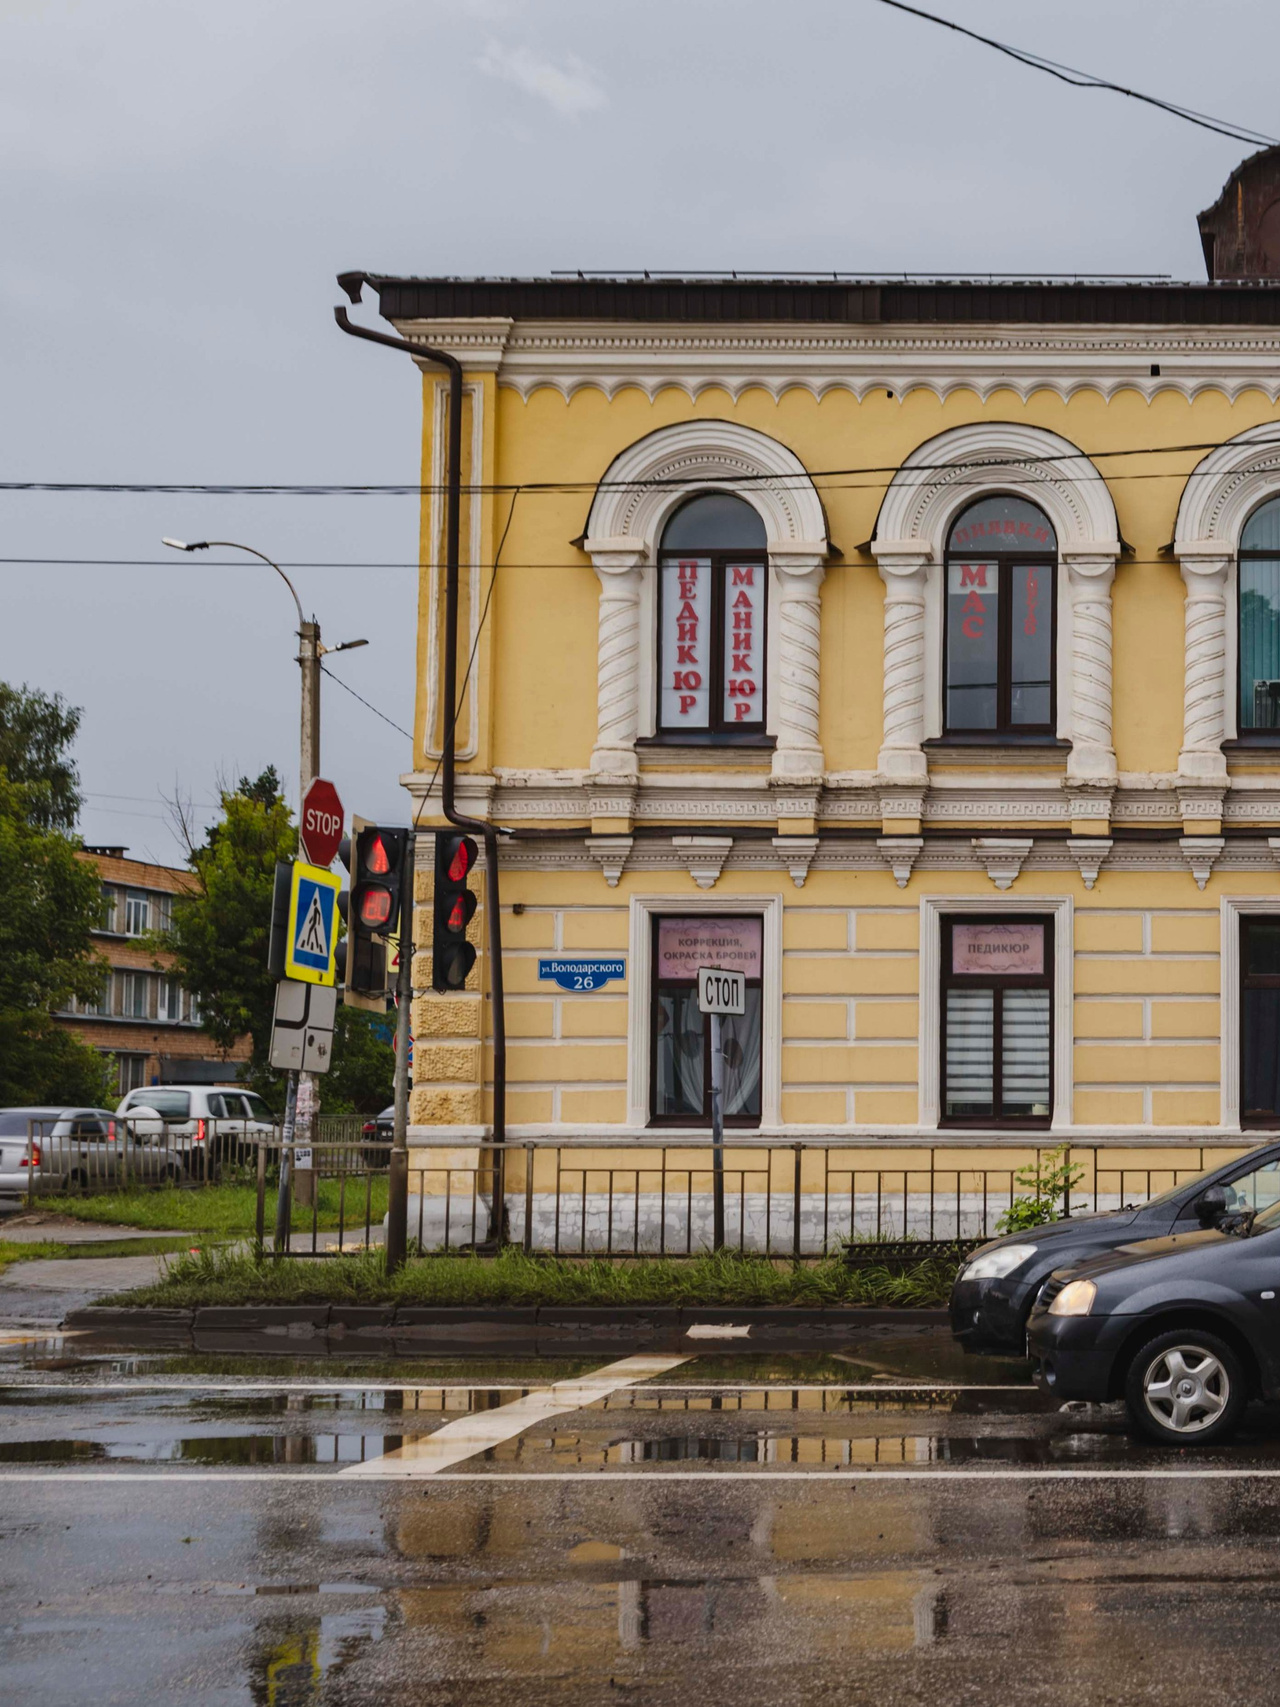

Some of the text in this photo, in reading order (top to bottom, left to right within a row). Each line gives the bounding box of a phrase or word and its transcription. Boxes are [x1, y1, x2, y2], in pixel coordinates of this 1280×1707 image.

[954, 519, 1050, 545] ПИЯВКИ
[673, 561, 702, 714] ПЕДИКЮР
[728, 567, 756, 721] МАНИКЮР
[305, 808, 341, 837] STOP
[664, 950, 757, 961] ОКРАСКА БРОВЕЙ
[678, 938, 743, 948] КОРРЕКЦИЯ,
[968, 943, 1030, 954] ПЕДИКЮР
[573, 976, 594, 989] 26
[705, 976, 739, 1007] СТОП
